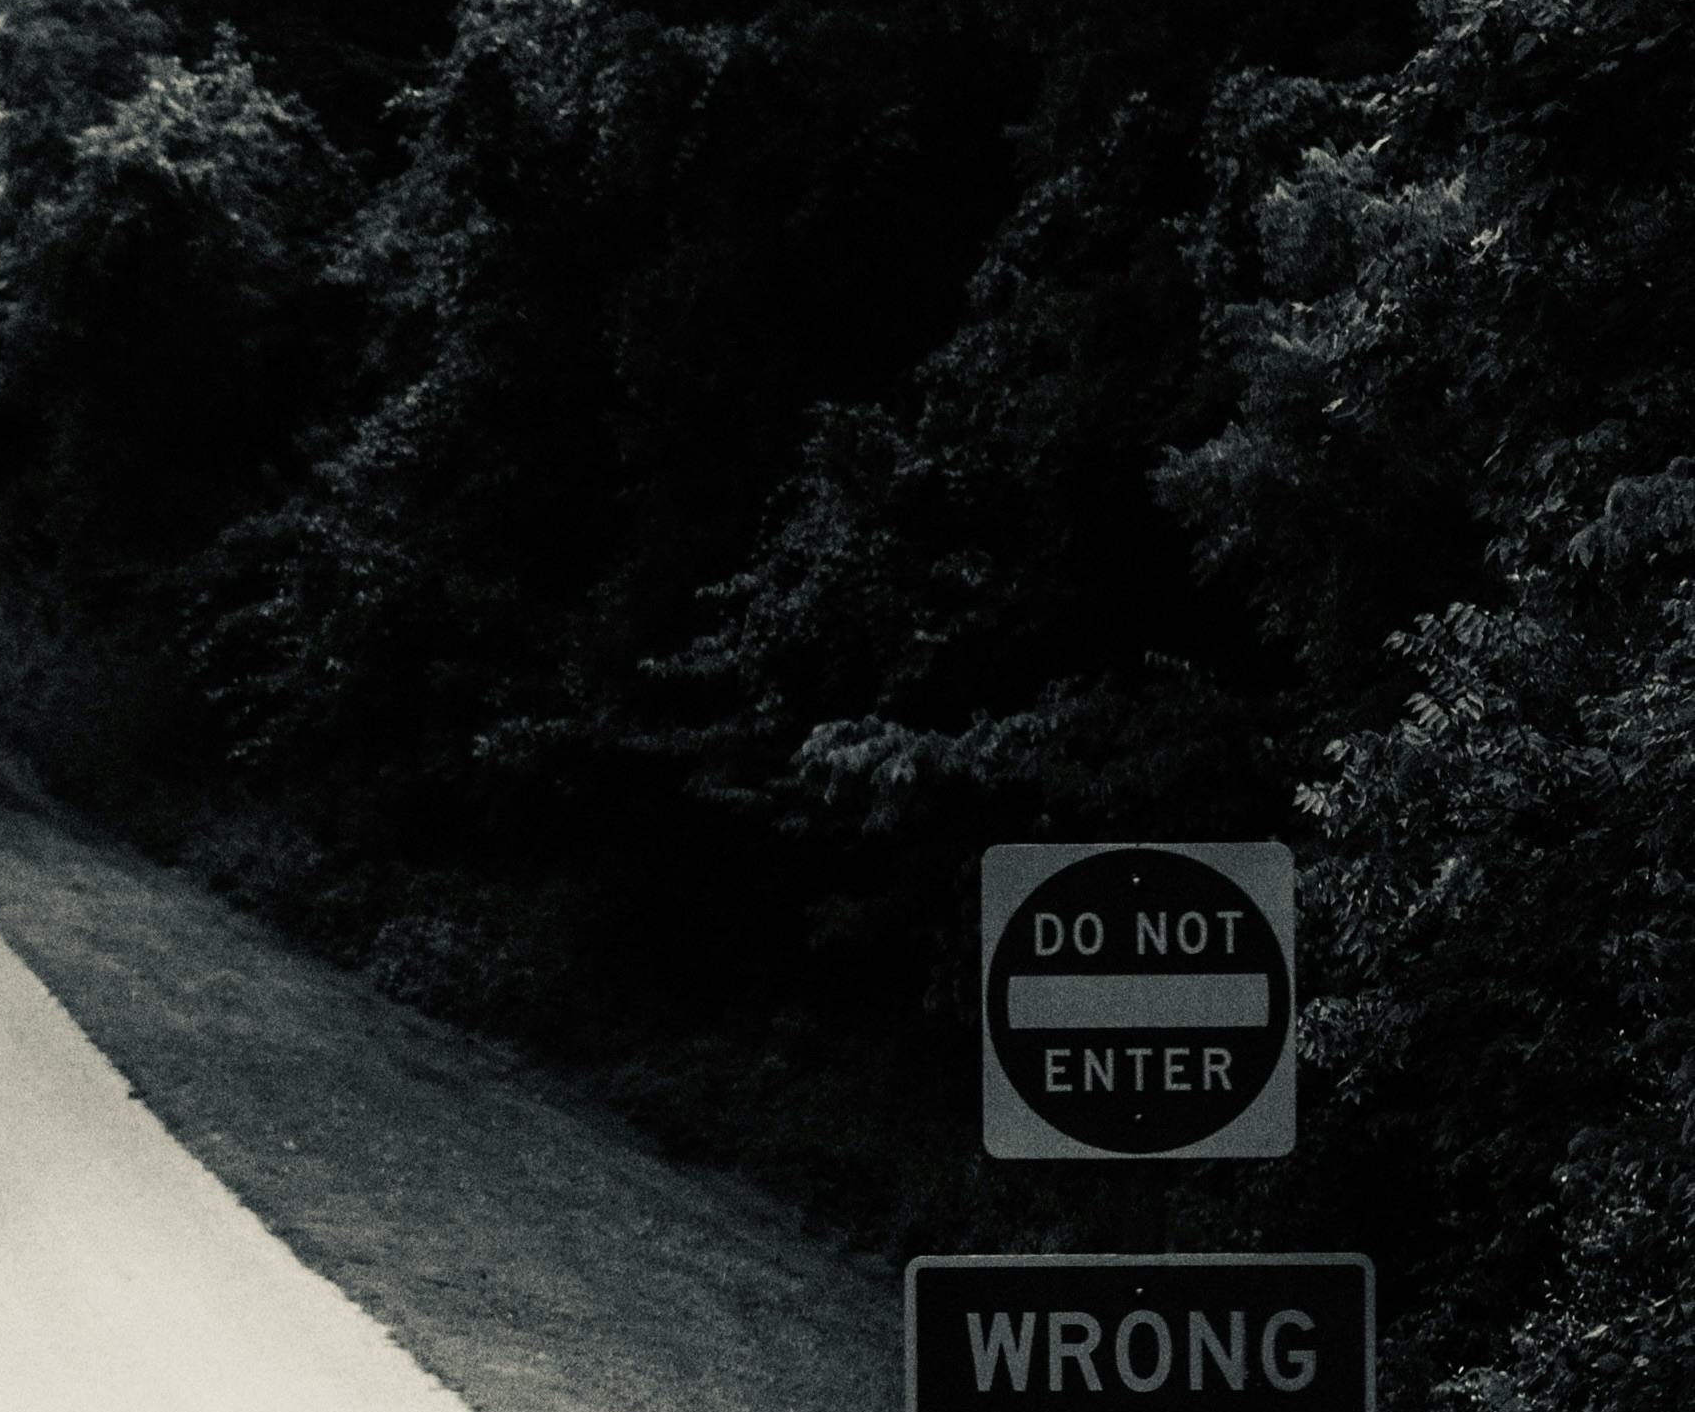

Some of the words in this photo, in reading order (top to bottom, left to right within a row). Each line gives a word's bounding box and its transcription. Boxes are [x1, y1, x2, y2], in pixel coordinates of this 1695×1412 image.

[1034, 911, 1104, 956] DO
[1136, 910, 1244, 955] NOT
[1044, 1047, 1233, 1092] ENTER
[966, 1309, 1317, 1393] WRONG
